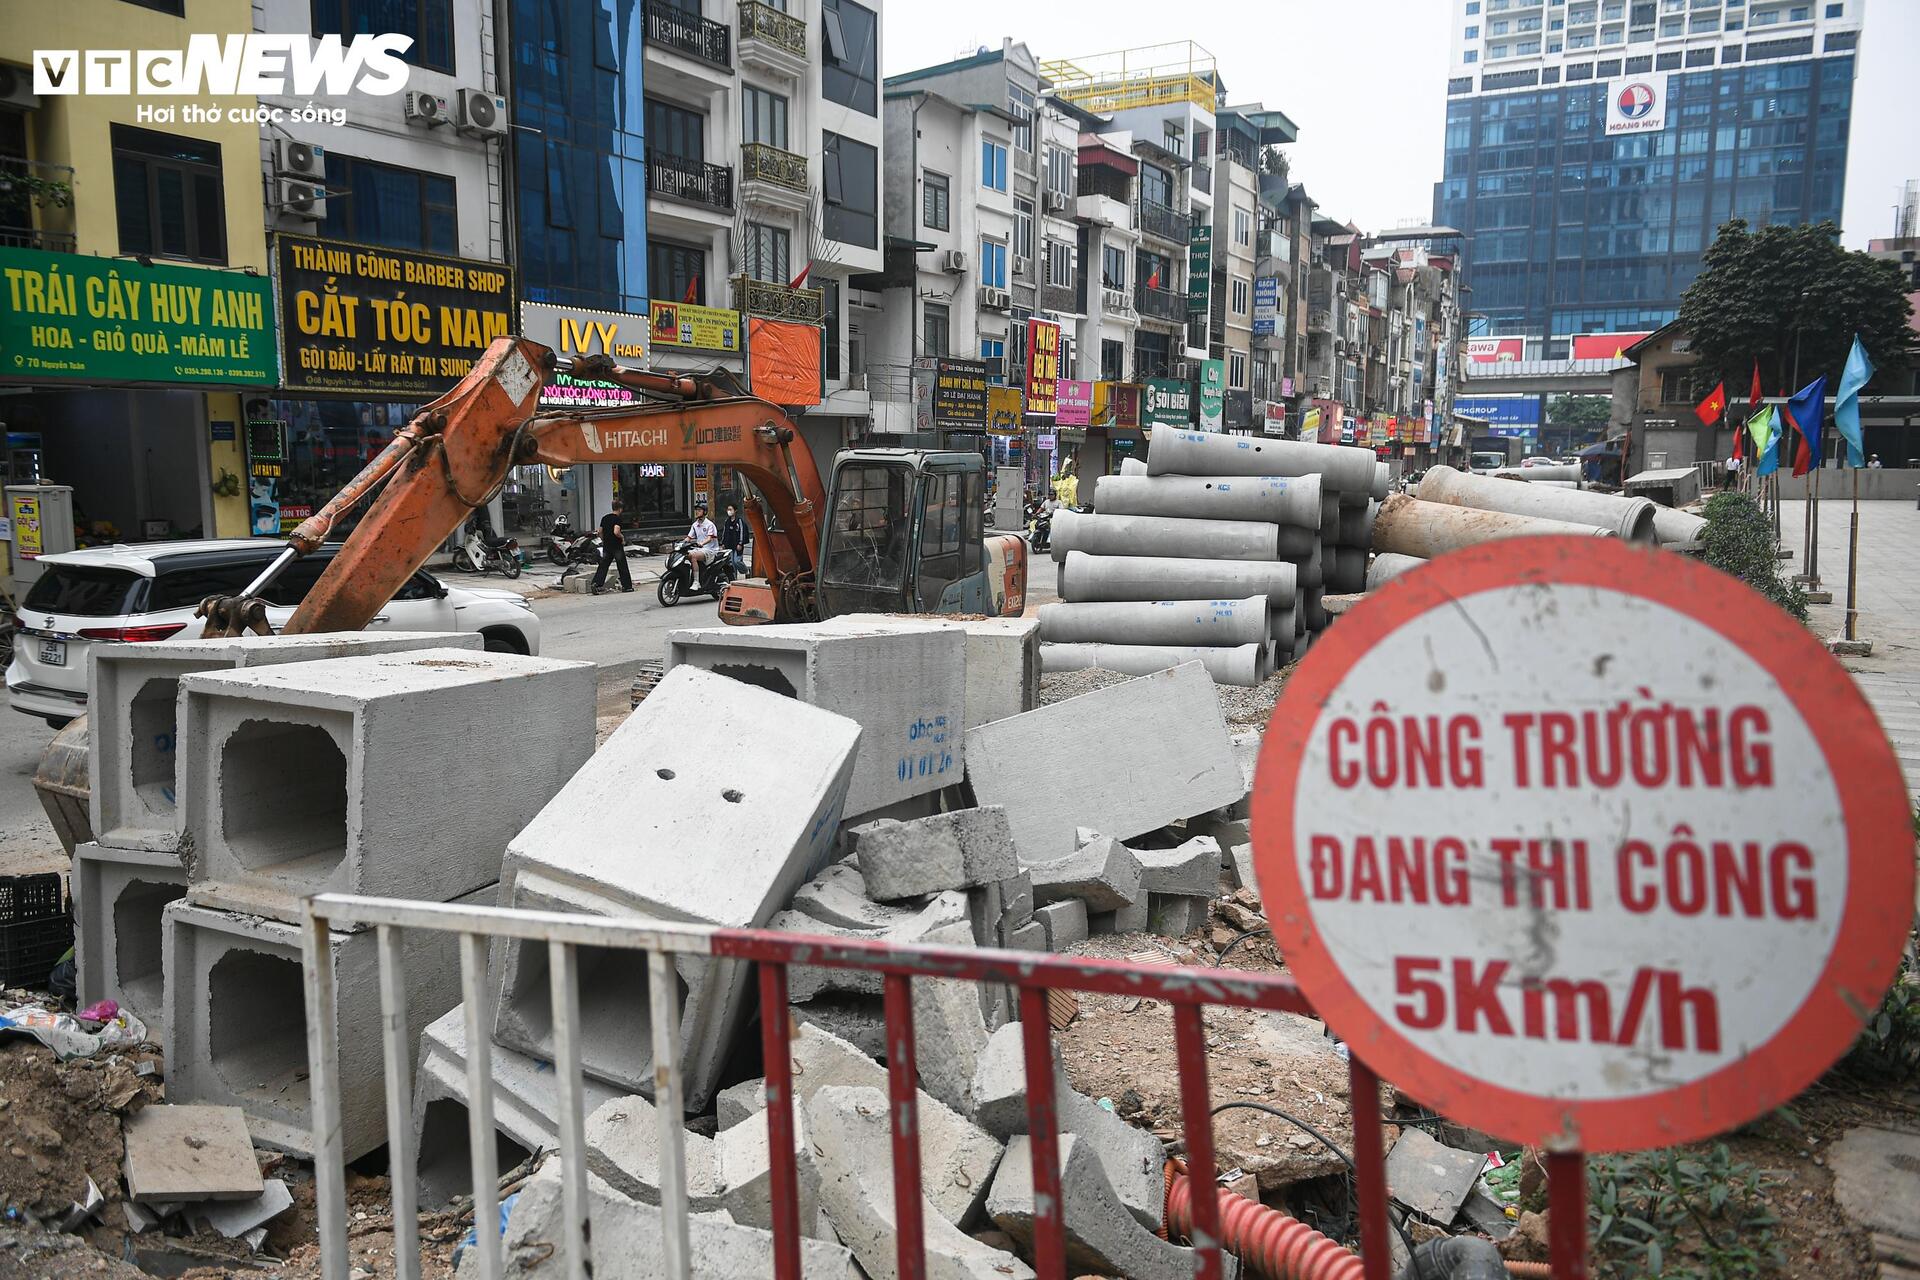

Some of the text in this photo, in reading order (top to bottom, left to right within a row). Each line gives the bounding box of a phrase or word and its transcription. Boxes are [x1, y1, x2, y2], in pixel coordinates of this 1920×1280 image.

[292, 244, 505, 293] THÀNH CÔNG BARBER SHOP
[4, 263, 263, 330] TRÁI CÂY HUY ANH
[296, 276, 508, 349] CẮT TÓC NAM
[32, 325, 73, 348] HOA
[93, 324, 126, 352] GIỎ
[132, 331, 169, 356] QUÀ
[231, 333, 249, 359] LỄ
[560, 318, 643, 358] IVY HAIR
[26, 357, 39, 368] 70
[300, 344, 325, 374] GỘI
[329, 344, 355, 371] ĐẦU
[365, 347, 386, 373] LẤY
[391, 348, 414, 375] RÁY
[418, 355, 436, 376] TAI
[557, 373, 572, 386] IVY
[561, 384, 581, 398] TÓC
[1156, 387, 1169, 409] SÓI
[1170, 387, 1190, 410] BIỂN
[605, 429, 667, 449] HITACHI
[641, 464, 664, 477] HAIR
[1326, 686, 1774, 790] CÔNG TRƯỜNG
[1310, 823, 1818, 921] ĐANG THI CÔNG
[1394, 956, 1721, 1054] 5Km/h
